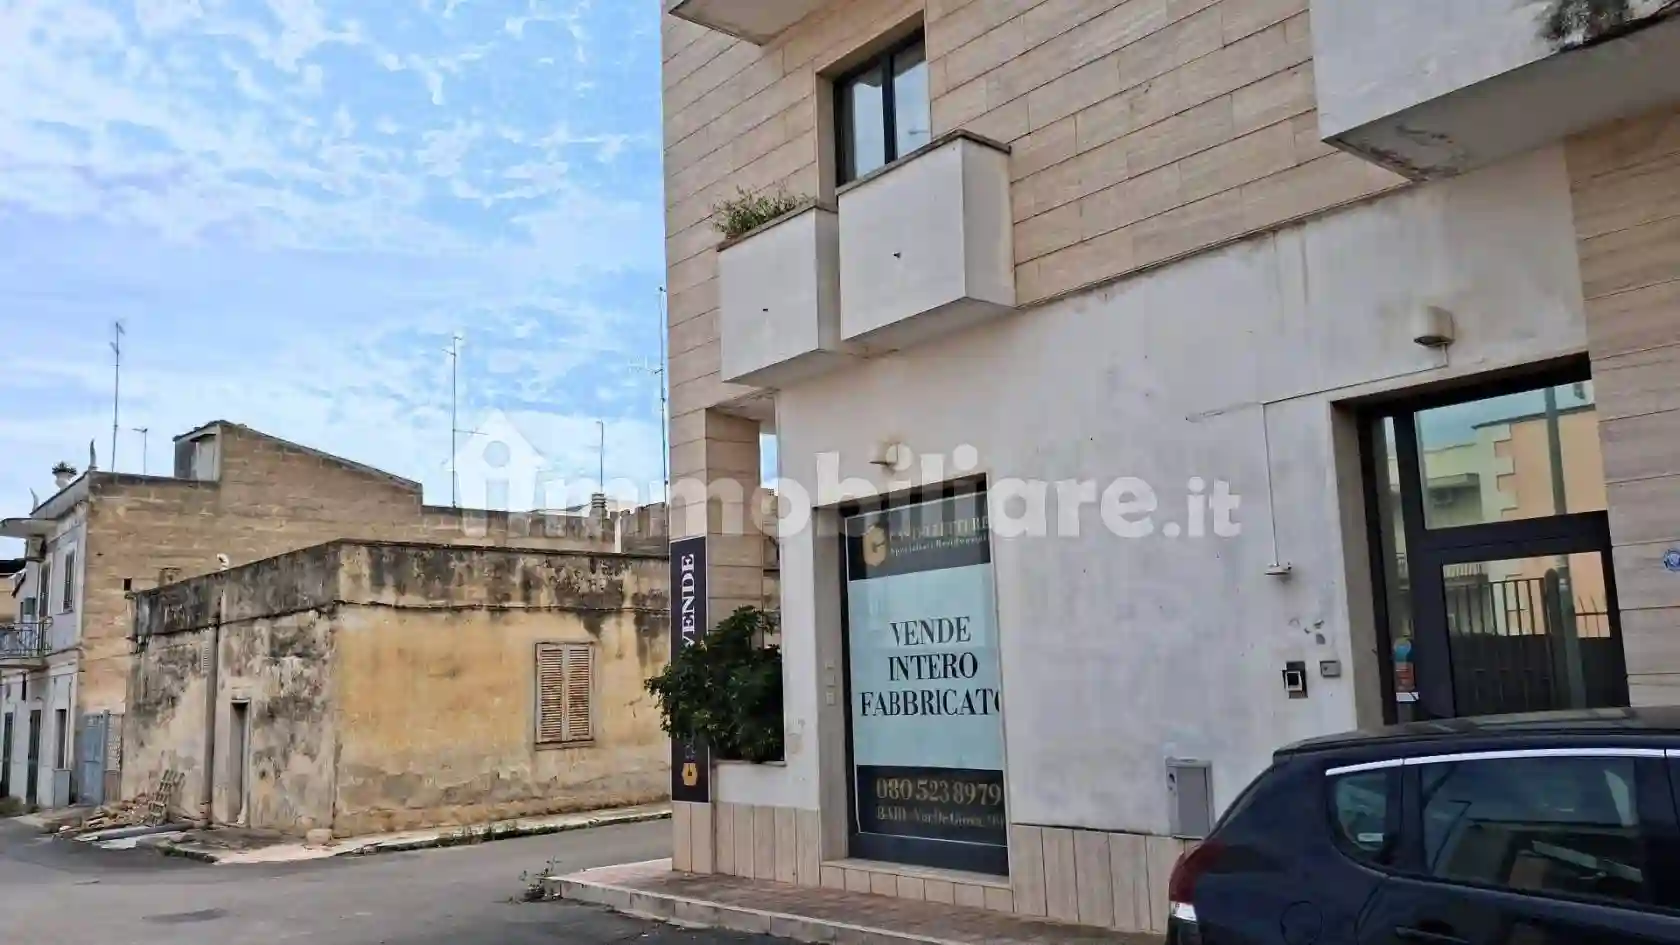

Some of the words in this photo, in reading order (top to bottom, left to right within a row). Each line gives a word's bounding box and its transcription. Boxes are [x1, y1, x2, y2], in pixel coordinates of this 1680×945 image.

[890, 616, 972, 646] VENDE
[888, 652, 978, 681] INTERO
[952, 781, 1001, 806] 8979
